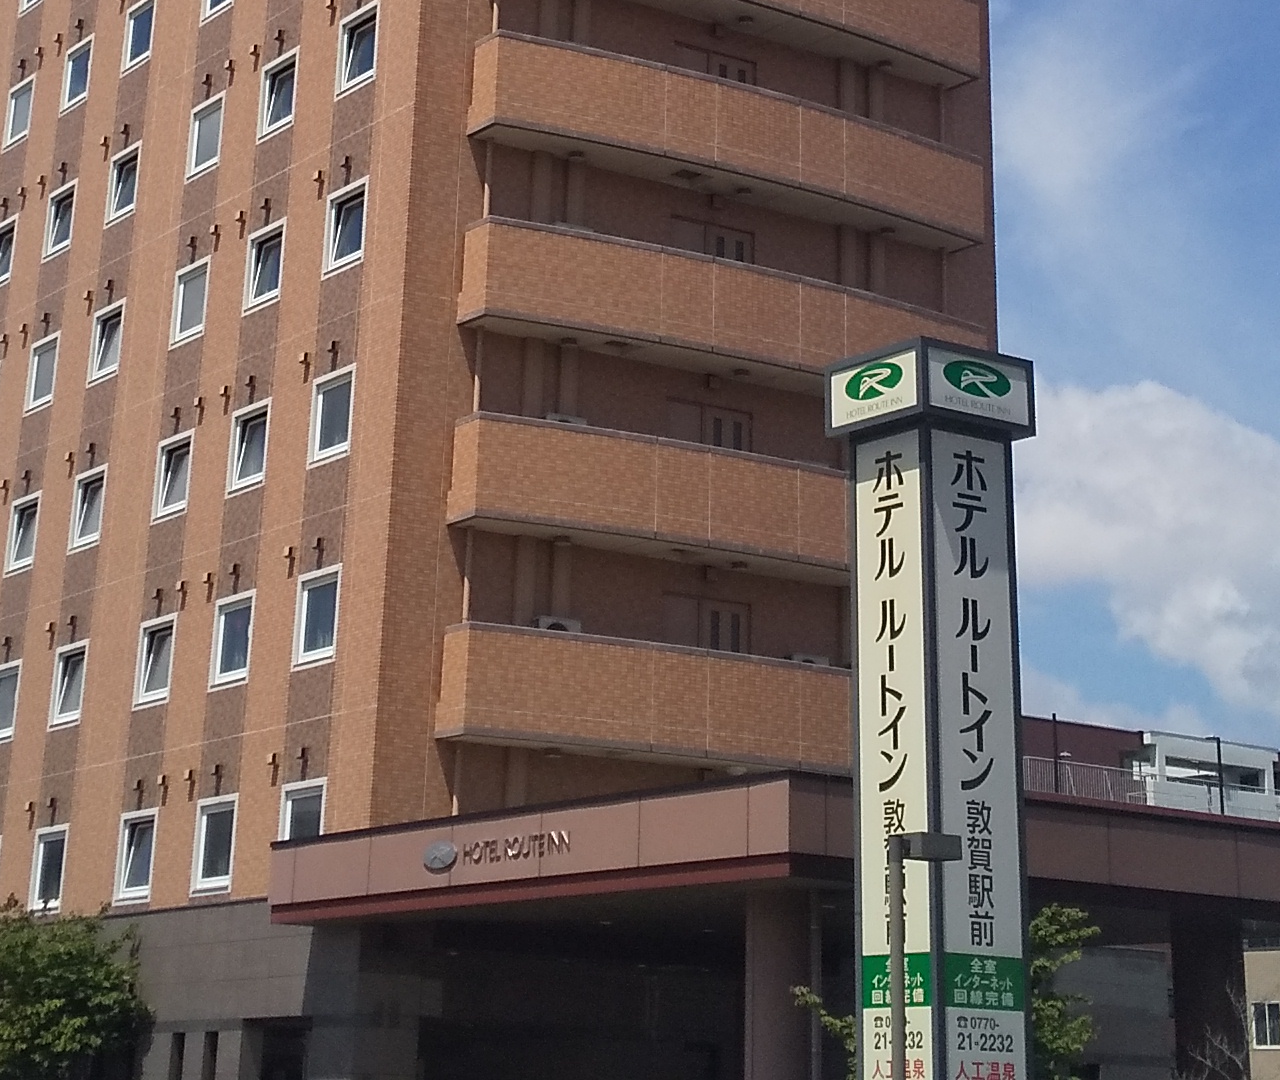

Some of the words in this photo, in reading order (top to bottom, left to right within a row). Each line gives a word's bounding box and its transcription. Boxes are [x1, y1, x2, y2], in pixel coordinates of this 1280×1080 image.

[846, 405, 865, 419] HOTEL
[867, 400, 889, 413] ROUTE
[890, 396, 903, 408] INN
[944, 394, 969, 409] HOTEL
[971, 399, 996, 413] ROUTE
[996, 403, 1011, 416] INN
[872, 450, 906, 581] ホテル
[951, 450, 990, 580] ホテル
[875, 597, 909, 793] ルートイン
[955, 596, 995, 791] ルートイン
[463, 839, 501, 865] HOTEL
[504, 833, 545, 861] ROUTE
[547, 830, 571, 855] INN
[966, 799, 995, 947] 敦賀駅前
[970, 958, 997, 974] 全室
[954, 973, 1013, 991] インターネット
[954, 989, 1014, 1007] 回線完備
[956, 1060, 1016, 1080] 人工温泉
